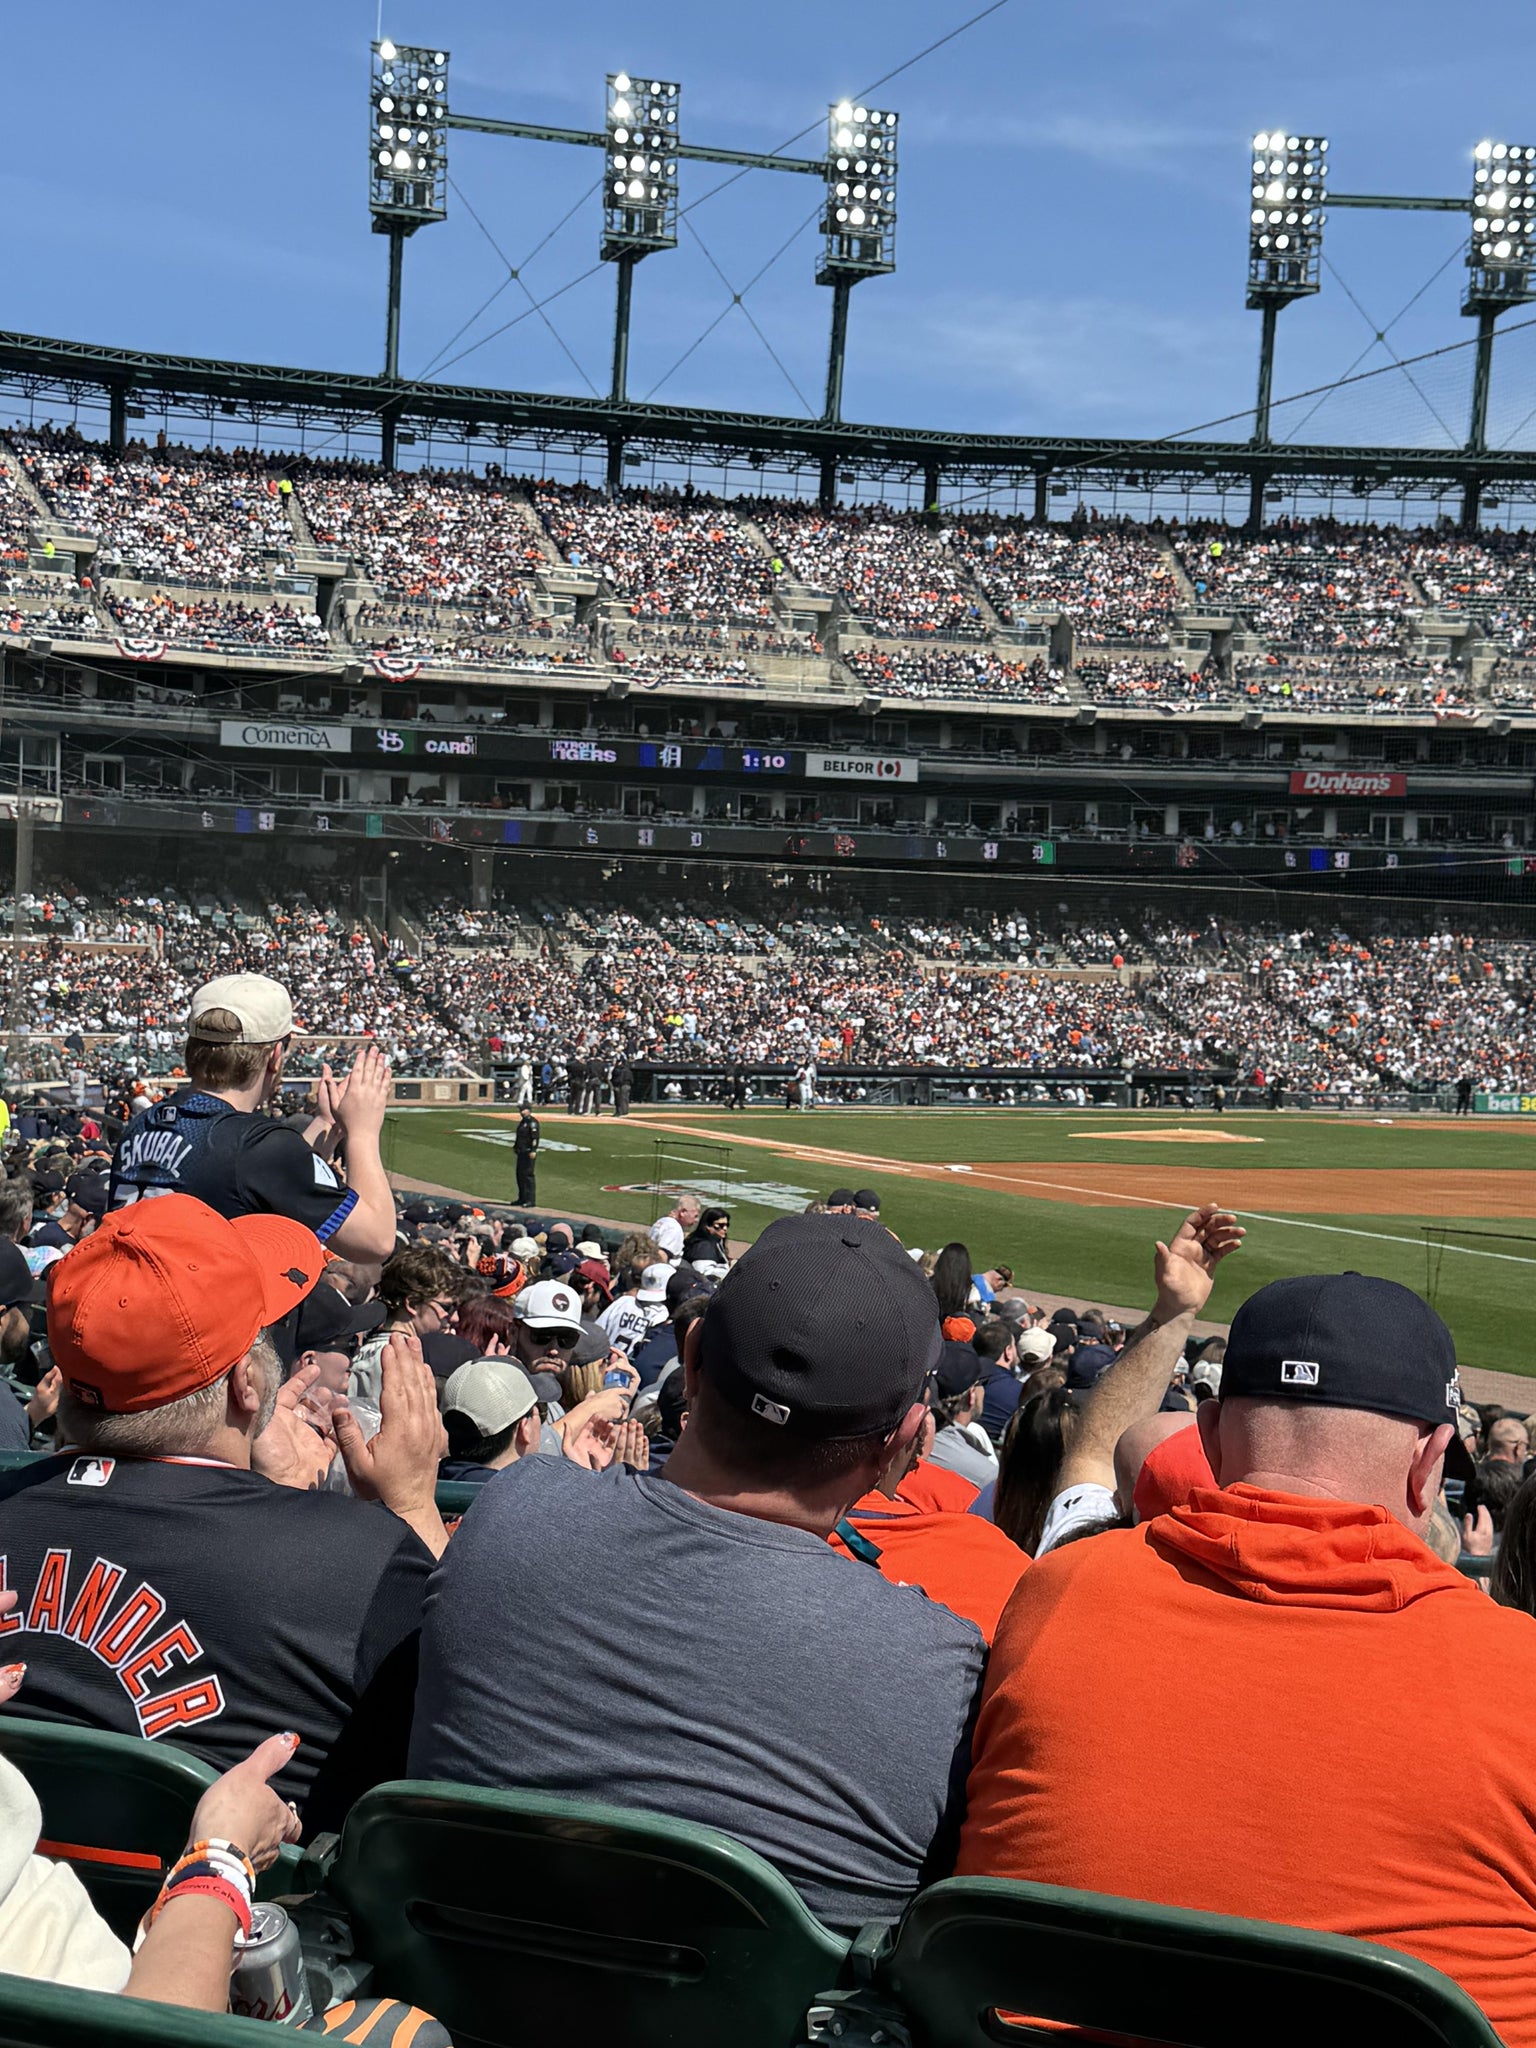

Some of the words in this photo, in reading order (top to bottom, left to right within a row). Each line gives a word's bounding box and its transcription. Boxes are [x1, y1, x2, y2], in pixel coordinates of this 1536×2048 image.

[742, 754, 786, 769] 1:10
[823, 760, 874, 774] BELFOR
[1303, 772, 1391, 790] Dunham's
[121, 1131, 193, 1178] SKUBAL
